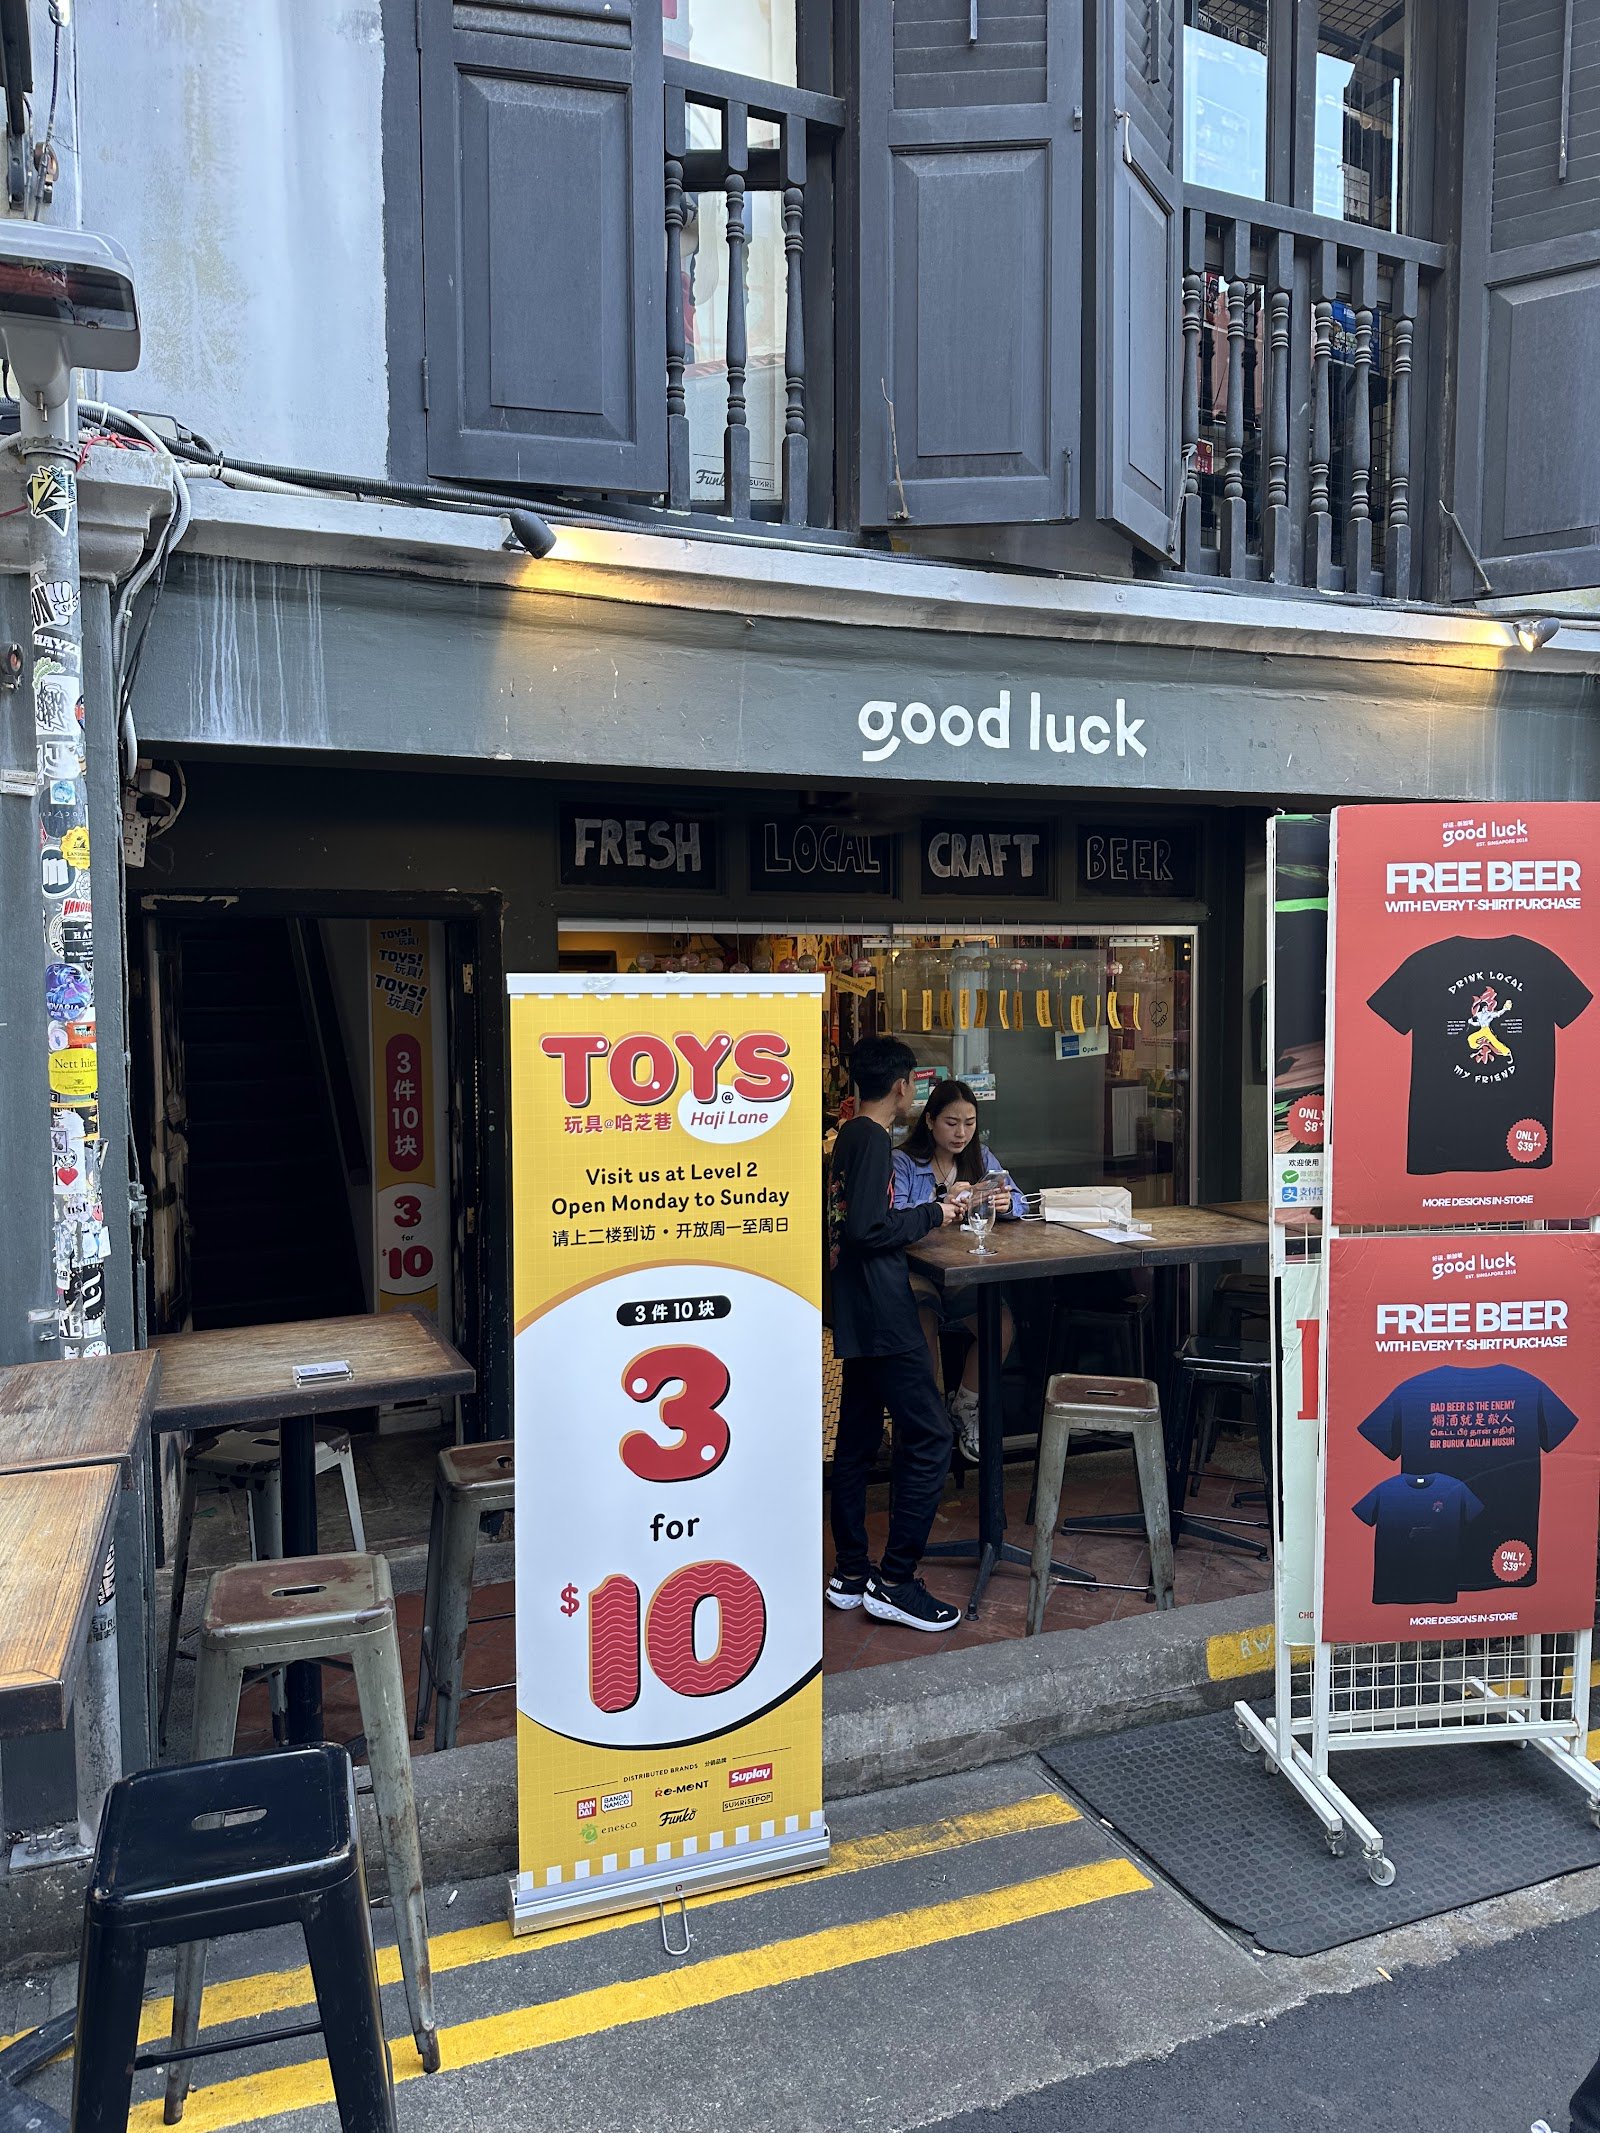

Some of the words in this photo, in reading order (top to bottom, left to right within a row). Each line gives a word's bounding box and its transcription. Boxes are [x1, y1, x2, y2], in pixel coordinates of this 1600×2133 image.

[858, 690, 1010, 762] good
[1030, 692, 1147, 757] luck
[1442, 822, 1486, 848] good
[1492, 819, 1528, 838] luck
[574, 818, 702, 872] FRESH
[764, 822, 880, 874] LOCAL
[928, 832, 1040, 877] CRAFT
[1086, 836, 1174, 881] BEER
[1387, 862, 1482, 894] FREE
[1487, 860, 1581, 892] BEER
[1385, 900, 1421, 913] WITH
[1422, 900, 1464, 912] EVERY
[1465, 899, 1515, 911] T-SHIRT
[1515, 897, 1581, 910] PURCHASE
[380, 927, 412, 939] TOYS!
[379, 949, 424, 967] TOYS!
[375, 974, 428, 1001] TOYS!
[1448, 971, 1484, 994] DRINK
[1489, 971, 1523, 992] LOCAL
[55, 1058, 78, 1069] Nett
[540, 1030, 794, 1108] TOYS
[1475, 1065, 1516, 1083] FRIEND
[691, 1111, 725, 1129] Haji
[728, 1111, 769, 1125] Lane
[1516, 1130, 1540, 1141] ONLY
[586, 1167, 633, 1186] Visit
[639, 1170, 660, 1183] us
[665, 1166, 686, 1181] at
[691, 1162, 741, 1180] Level
[746, 1162, 758, 1177] 2
[552, 1198, 605, 1219] Open
[612, 1192, 689, 1213] Monday
[694, 1192, 715, 1207] to
[720, 1187, 789, 1207] Sunday
[1422, 1197, 1451, 1207] MORE
[1452, 1196, 1492, 1206] DESIGNS
[1492, 1194, 1534, 1205] IN-STORE
[393, 1195, 422, 1228] 3
[401, 1234, 414, 1242] for
[1432, 1255, 1475, 1280] good
[1481, 1251, 1516, 1269] luck
[1377, 1303, 1470, 1334] FREE
[1476, 1300, 1568, 1332] BEER
[1375, 1340, 1413, 1352] WITH
[1413, 1339, 1454, 1351] EVERY
[1455, 1338, 1502, 1350] T-SHIRT
[1503, 1336, 1567, 1349] PURCHASE
[619, 1344, 731, 1483] 3
[1430, 1402, 1445, 1412] BAD
[1446, 1402, 1465, 1411] BEER
[1466, 1401, 1475, 1411] IS
[1476, 1401, 1489, 1410] THE
[1491, 1400, 1516, 1410] ENEMY
[1430, 1440, 1441, 1449] BIR
[1442, 1439, 1465, 1448] BURUK
[1466, 1438, 1491, 1448] ADALAH
[1491, 1437, 1515, 1447] MUSUH
[650, 1513, 700, 1542] for
[1501, 1551, 1524, 1561] ONLY
[1409, 1617, 1439, 1625] MORE
[1439, 1615, 1478, 1624] DESIGNS
[1478, 1612, 1518, 1622] IN-STORE
[623, 1769, 669, 1782] DISTRIBUTED
[671, 1763, 698, 1775] BRANDS
[731, 1767, 771, 1783] Suplay
[578, 1800, 595, 1809] BAN
[603, 1793, 630, 1803] BANDAI
[603, 1799, 630, 1809] NAMCO
[578, 1808, 592, 1817] DAI
[659, 1807, 698, 1826] Funko
[601, 1821, 637, 1834] enesco
